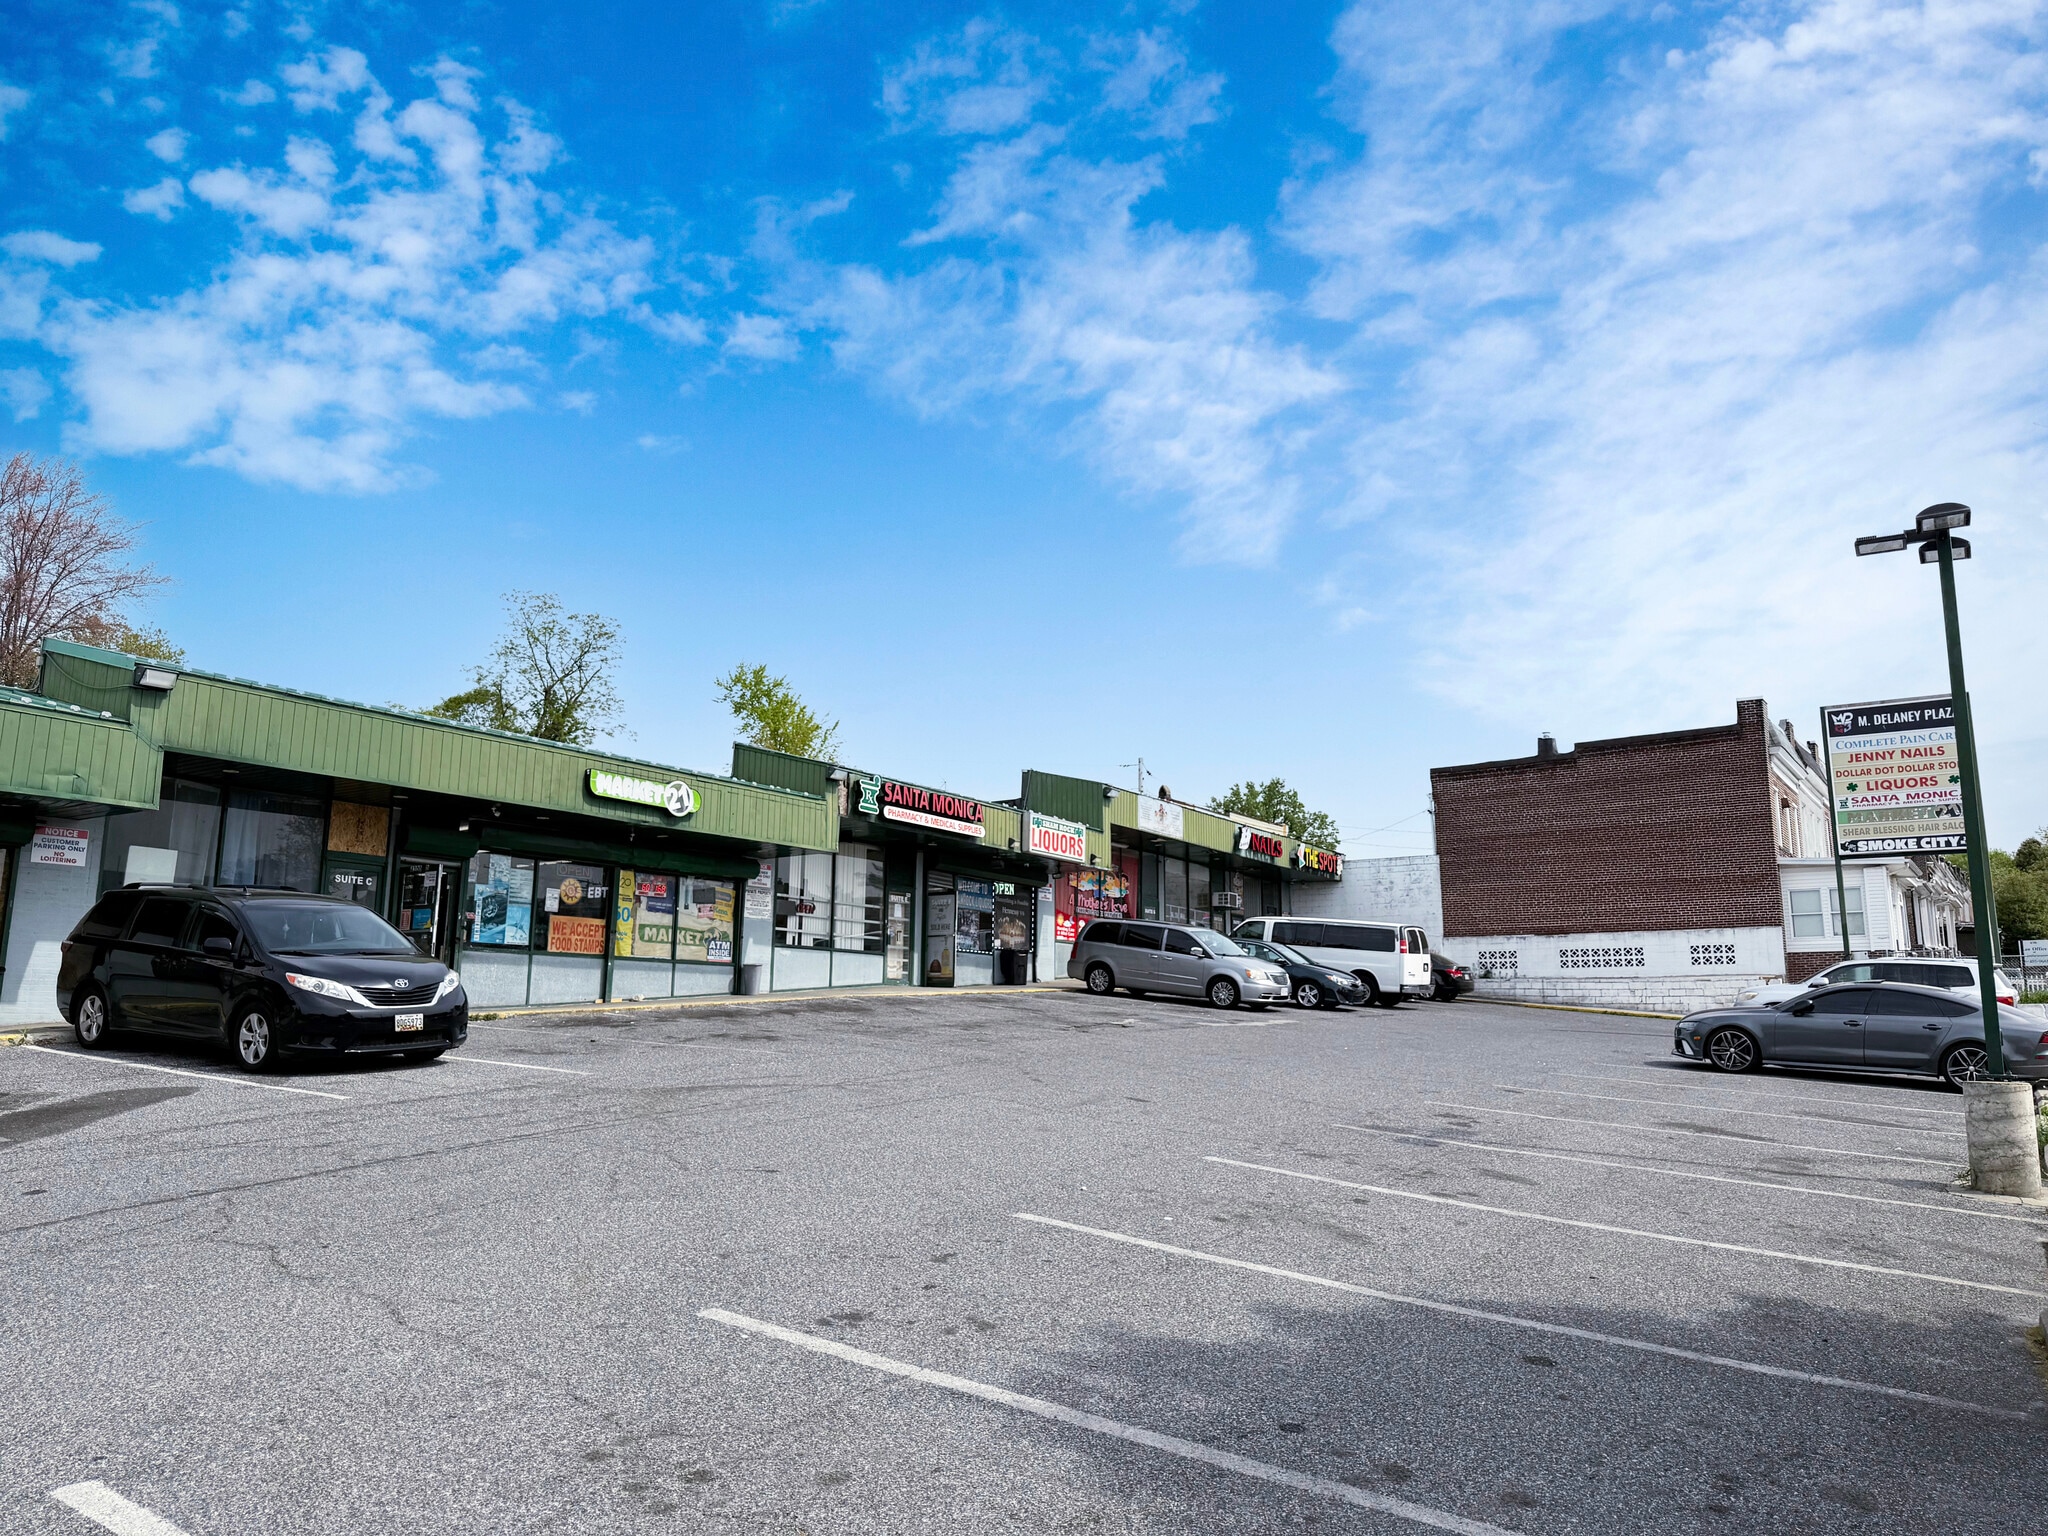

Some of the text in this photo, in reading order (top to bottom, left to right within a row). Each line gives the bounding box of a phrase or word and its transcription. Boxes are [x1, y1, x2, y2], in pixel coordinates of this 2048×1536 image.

[1858, 716, 1871, 727] M.
[1874, 710, 1920, 725] DELANEY
[1836, 731, 1955, 750] COMPLETE PAIN CAR
[1848, 746, 1945, 763] JENNY NAILS
[1836, 760, 1958, 778] DOLLAR DOT DOLLAR STO
[596, 771, 692, 812] MARKET 21
[1866, 776, 1938, 791] LIQUORS
[884, 781, 984, 823] SANTA MONICA
[1851, 789, 1961, 804] SANTA MONIC
[1852, 800, 1893, 808] PHARMACY
[887, 808, 982, 836] PHARMACY & MEDICAL SUPPLIES
[1843, 826, 1871, 837] SHEAR
[1873, 824, 1916, 835] BLESSING
[1918, 821, 1940, 832] HAIR
[45, 827, 79, 838] NOTICE
[33, 843, 86, 853] PARKING ONLY
[41, 837, 80, 847] CUSTOMER
[1031, 827, 1083, 857] LIQUORS
[1251, 832, 1283, 859] NAILS
[1857, 840, 1918, 853] SMOKE
[1920, 836, 1959, 850] CITY
[40, 855, 77, 864] LOITERING
[1305, 847, 1337, 874] THE SPOT
[334, 874, 373, 885] SUITE C
[587, 886, 609, 899] EBT
[552, 921, 567, 936] WE
[569, 923, 606, 939] ACCEPT
[550, 937, 605, 953] FOOD STAMPS
[708, 949, 730, 957] INSIDE
[709, 940, 730, 950] ATM
